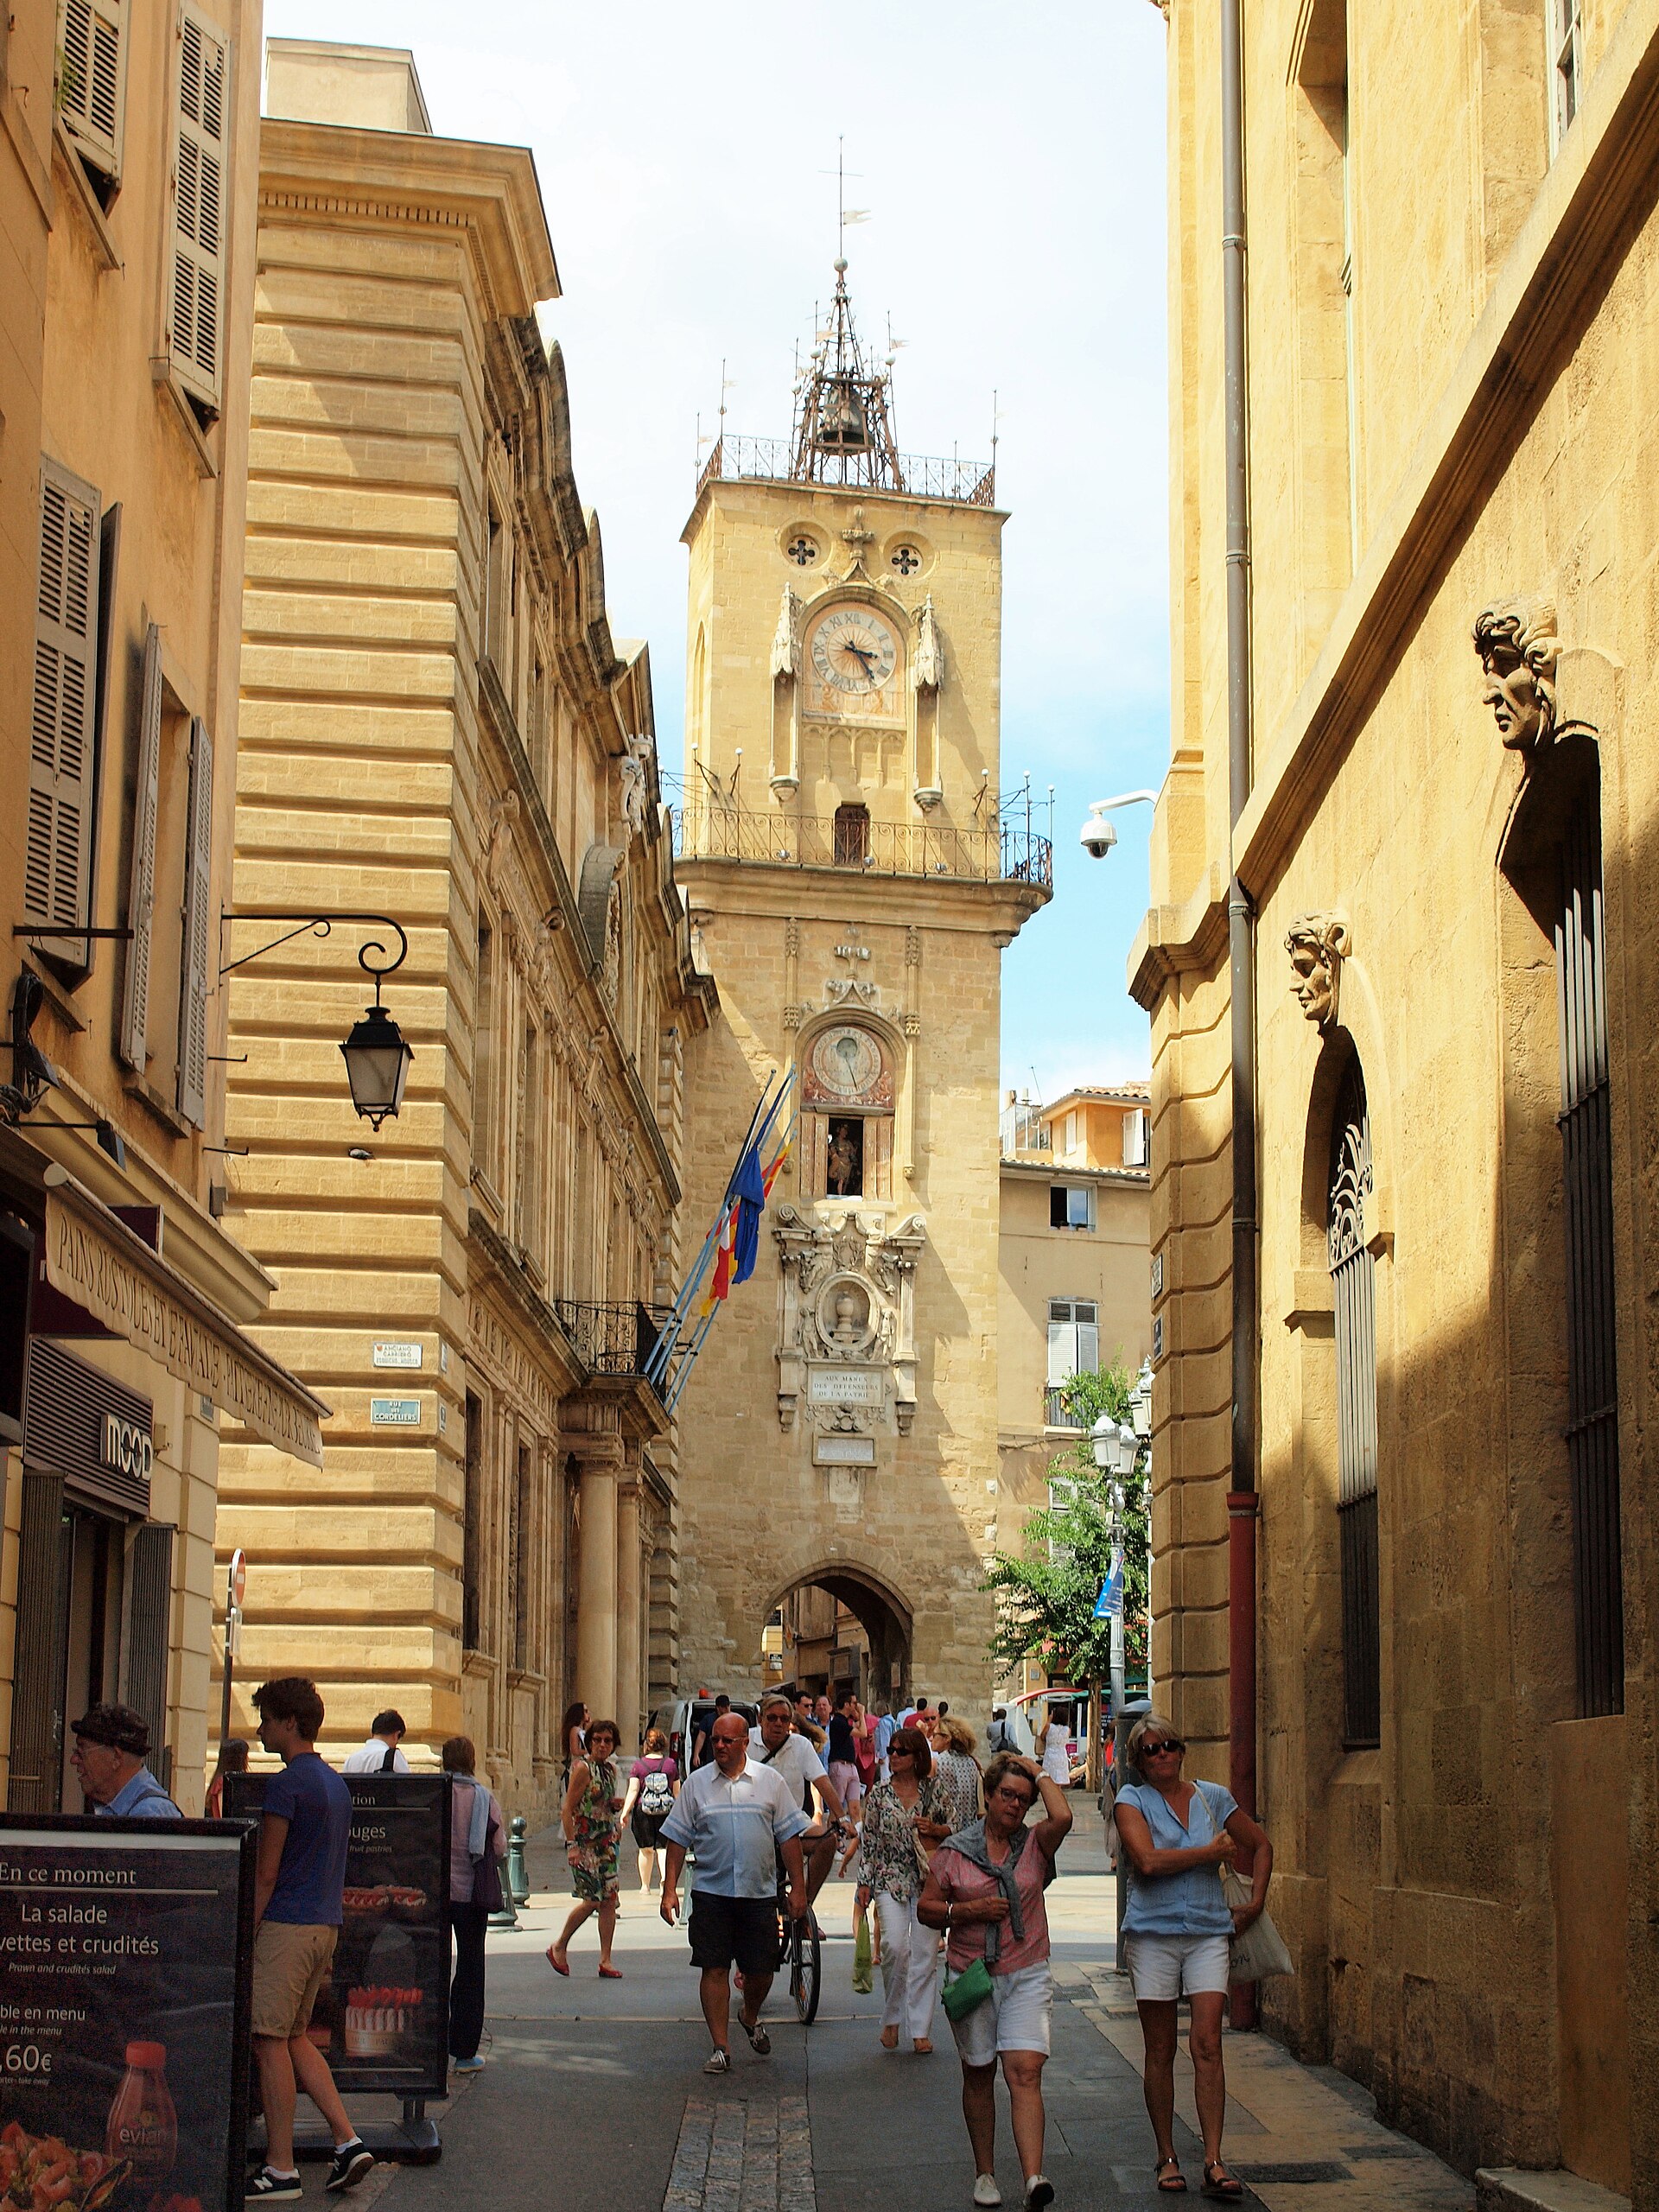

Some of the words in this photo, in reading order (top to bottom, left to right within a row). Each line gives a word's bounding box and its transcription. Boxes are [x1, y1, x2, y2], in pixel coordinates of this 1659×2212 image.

[58, 1212, 94, 1292] PAINS
[97, 1244, 152, 1338] RUSTQUES
[153, 1294, 166, 1348] ET
[168, 1306, 178, 1358] E
[374, 1413, 416, 1421] CORDELIERS
[353, 1792, 376, 1805] tion
[0, 1862, 22, 1882] En
[28, 1867, 48, 1882] ce
[54, 1867, 137, 1885] moment
[22, 1904, 41, 1923] La
[48, 1904, 108, 1925] salade
[57, 1936, 76, 1955] et
[82, 1934, 159, 1956] crudités
[9, 1961, 35, 1974] Prawn
[37, 1963, 54, 1974] and
[55, 1964, 91, 1975] crudités
[92, 1965, 117, 1976] salad
[0, 2005, 21, 2019] ble
[24, 2008, 41, 2020] en
[46, 2008, 86, 2022] menu
[10, 2024, 18, 2034] in
[20, 2025, 35, 2036] the
[36, 2027, 62, 2036] menu
